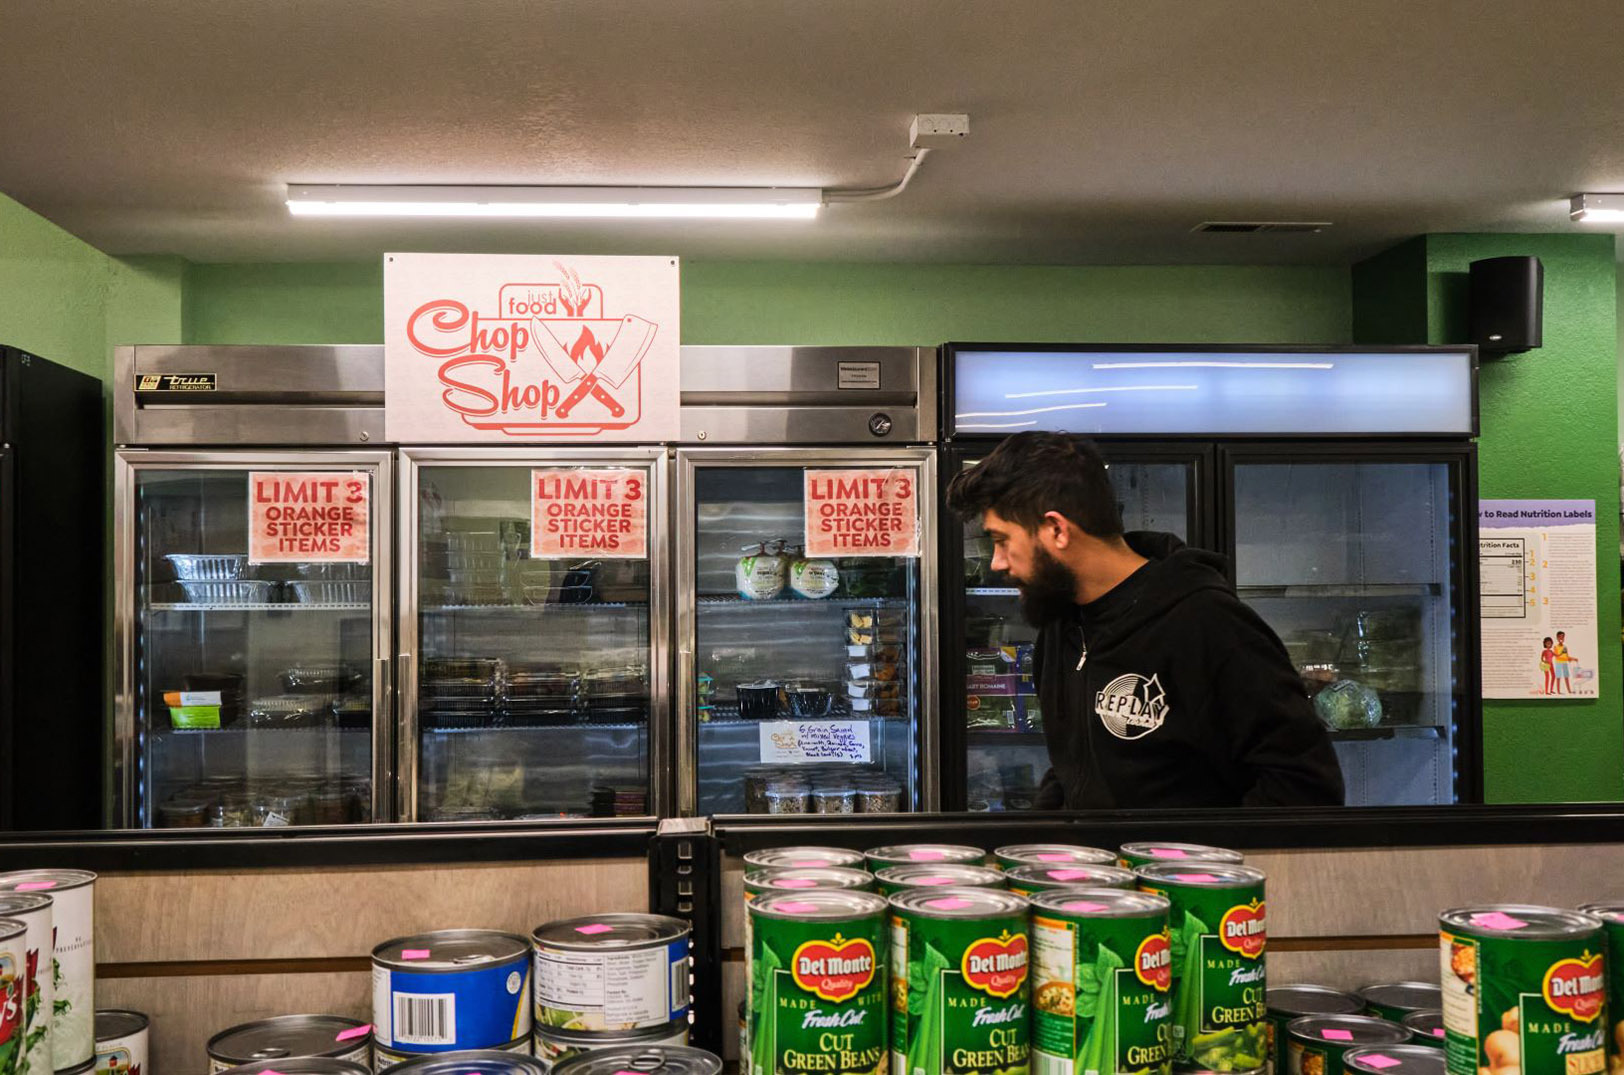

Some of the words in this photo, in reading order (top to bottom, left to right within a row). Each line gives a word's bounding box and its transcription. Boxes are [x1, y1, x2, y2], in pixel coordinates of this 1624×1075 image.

[509, 298, 557, 315] food
[527, 290, 554, 306] just
[407, 299, 529, 363] Chop
[438, 354, 561, 420] Shop
[257, 481, 339, 503] LIMIT
[346, 481, 363, 504] 3
[538, 478, 618, 500] LIMIT
[624, 479, 642, 500] 3
[811, 478, 889, 500] LIMIT
[895, 478, 912, 499] 3
[265, 506, 354, 521] ORANGE
[547, 503, 632, 517] ORANGE
[819, 502, 903, 517] ORANGE
[1496, 510, 1519, 518] Read
[1520, 510, 1562, 519] Nutrition
[1563, 510, 1593, 518] Labels
[266, 522, 353, 537] STICKER
[547, 518, 632, 533] STICKER
[821, 518, 902, 532] STICKER
[279, 538, 341, 552] ITEMS
[559, 534, 620, 548] ITEMS
[833, 533, 892, 548] ITEMS
[1096, 692, 1165, 720] REPLAY
[807, 725, 829, 734] Grain
[1226, 920, 1247, 938] Del
[799, 957, 825, 975] Del
[827, 955, 871, 975] Monte
[969, 955, 995, 973] Del
[1141, 951, 1160, 970] Del
[1207, 959, 1241, 969] MADE
[821, 979, 853, 991] Quality
[1228, 967, 1257, 987] Fresh
[1551, 977, 1578, 997] Del
[780, 997, 816, 1010] MADE
[948, 997, 986, 1008] MADE
[1122, 993, 1155, 1005] MADE
[802, 1010, 841, 1029] Fresh
[840, 1009, 867, 1027] Cut
[972, 1007, 1006, 1027] Fresh
[1212, 1006, 1254, 1023] GREEN
[1528, 1022, 1571, 1034] MADE
[819, 1032, 854, 1052] CUT
[989, 1028, 1017, 1047] CUT
[1557, 1032, 1595, 1055] Fresh
[783, 1049, 836, 1070] GREEN
[840, 1047, 880, 1069] BEANS
[953, 1048, 1003, 1068] GREEN
[1127, 1045, 1166, 1065] GREEN
